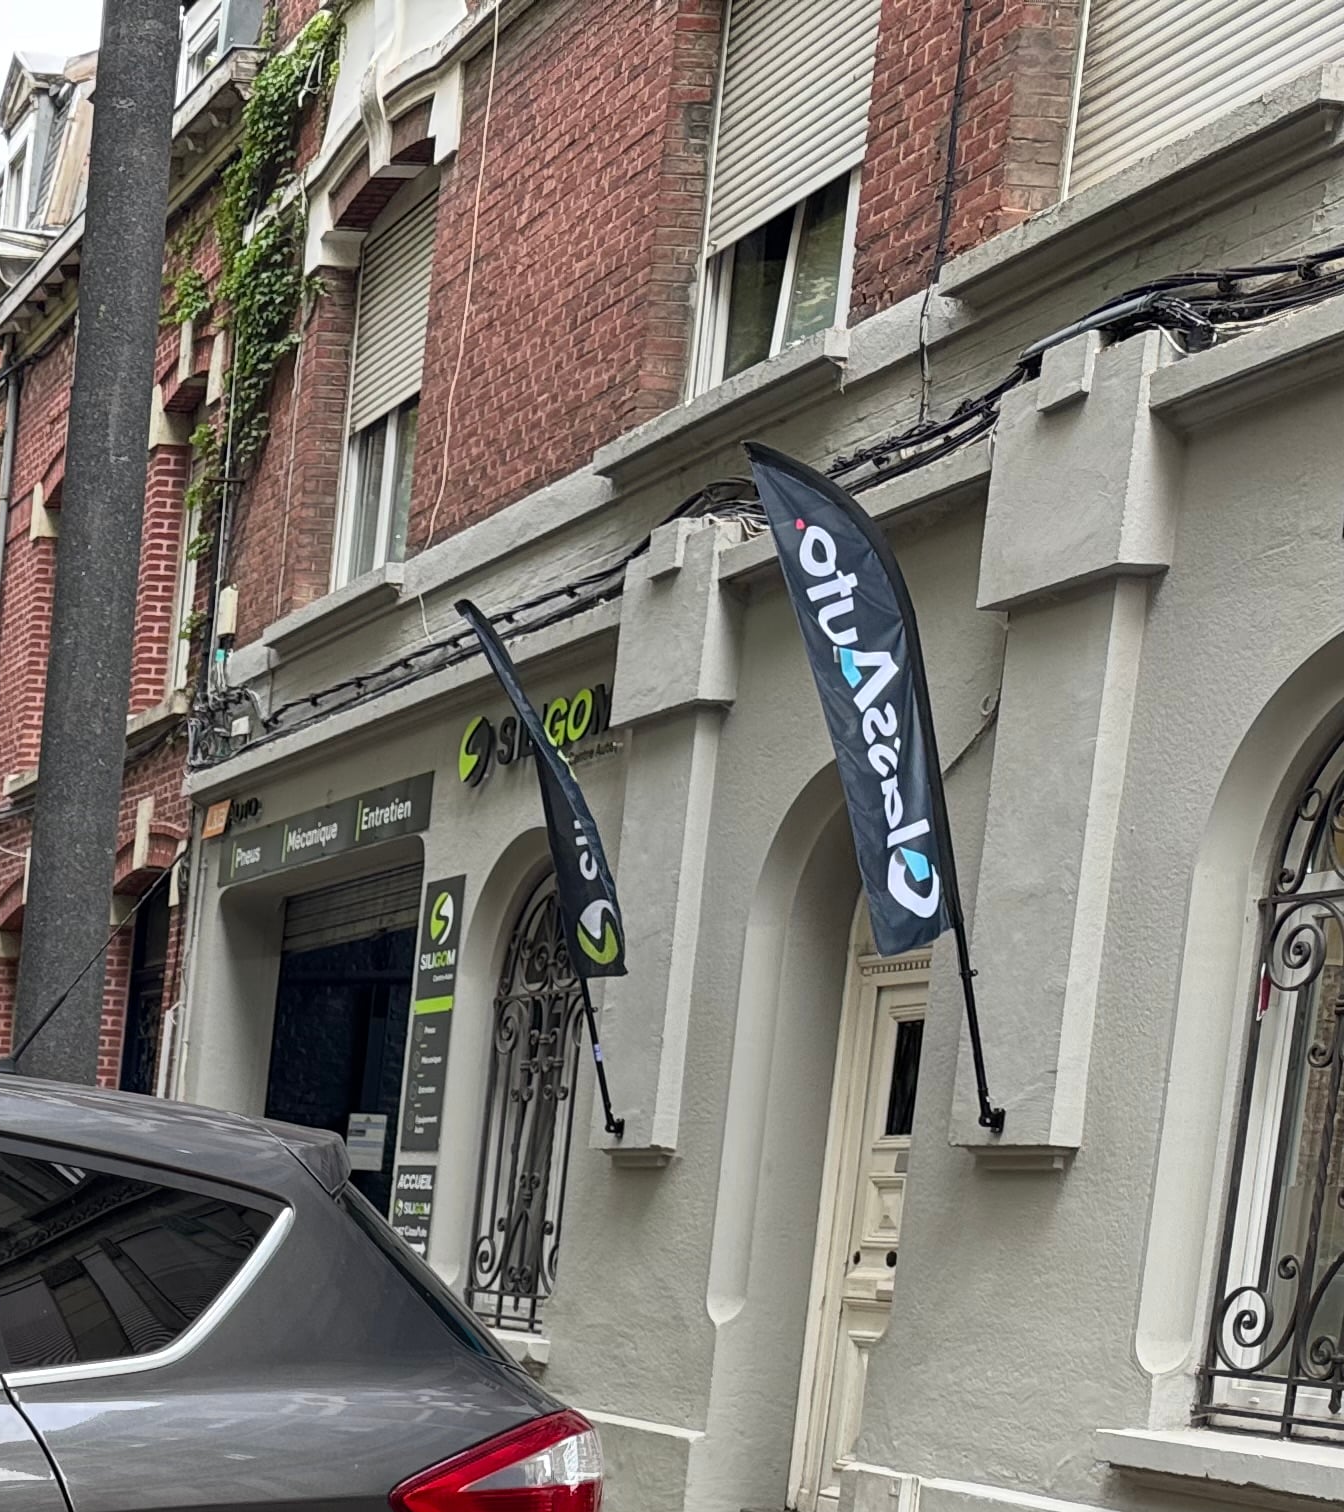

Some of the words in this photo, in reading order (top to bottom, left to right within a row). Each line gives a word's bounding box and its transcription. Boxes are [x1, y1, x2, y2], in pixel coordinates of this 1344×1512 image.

[235, 846, 261, 869] Pneus
[287, 821, 338, 852] Mécanique
[361, 799, 412, 831] Entretien
[420, 949, 456, 970] SILIGOM
[398, 1174, 433, 1190] ACCUEIL
